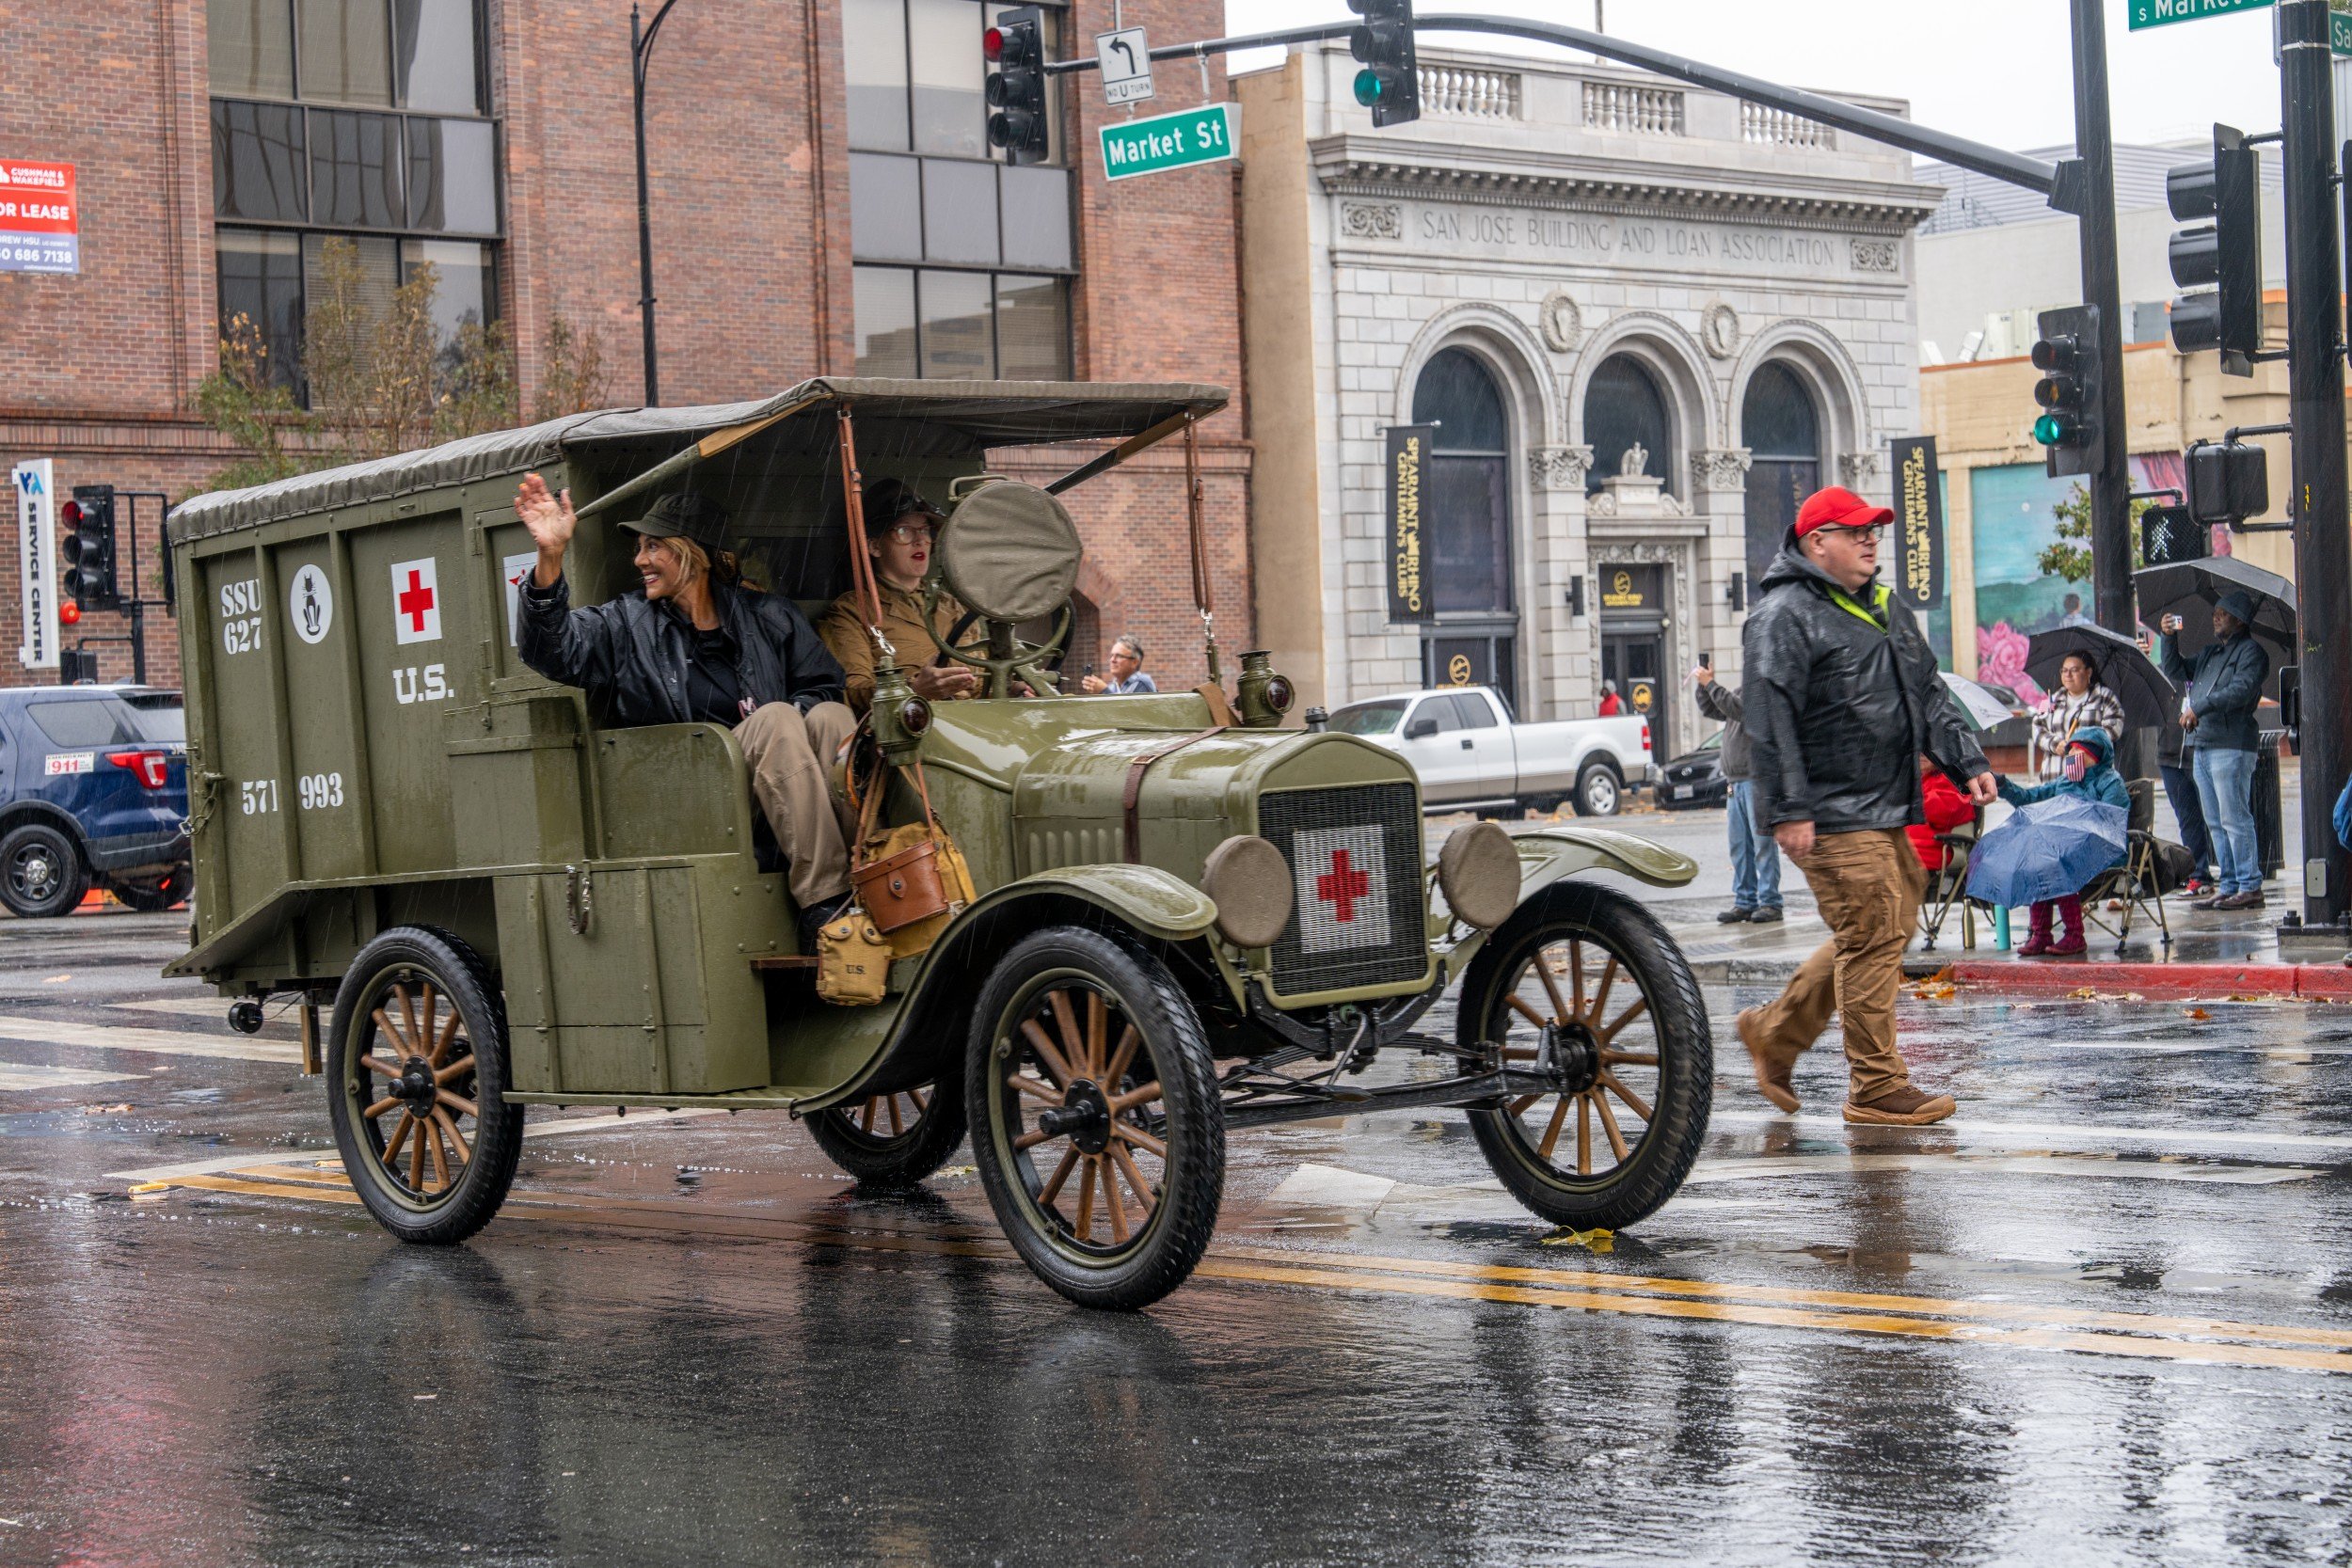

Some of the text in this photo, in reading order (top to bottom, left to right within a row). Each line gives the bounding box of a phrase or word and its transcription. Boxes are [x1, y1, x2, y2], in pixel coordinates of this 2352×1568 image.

[2335, 21, 2352, 49] Sa
[1107, 83, 1151, 98] NO U TURN
[1108, 119, 1223, 166] Market St
[10, 167, 64, 180] CUSHMAN &
[10, 176, 65, 187] WAKEFIELD
[21, 203, 70, 220] LEASE
[14, 248, 40, 261] 686
[43, 249, 72, 263] 7138
[1422, 211, 1835, 266] SAN JOSE BUILDING AND LOAN ASSOCIATION
[1406, 436, 1422, 612] SPEARMINT RHINO
[1912, 446, 1931, 601] SPEARMINT RHINO
[28, 502, 42, 662] SERVICE CENTER
[1396, 552, 1409, 598] CLUBS
[1906, 548, 1919, 591] CLUBS
[220, 578, 262, 618] SSU
[223, 617, 262, 655] 627
[392, 663, 454, 704] U.S.
[52, 760, 78, 773] 911
[242, 772, 344, 816] 571 993
[846, 964, 866, 975] U.S.
